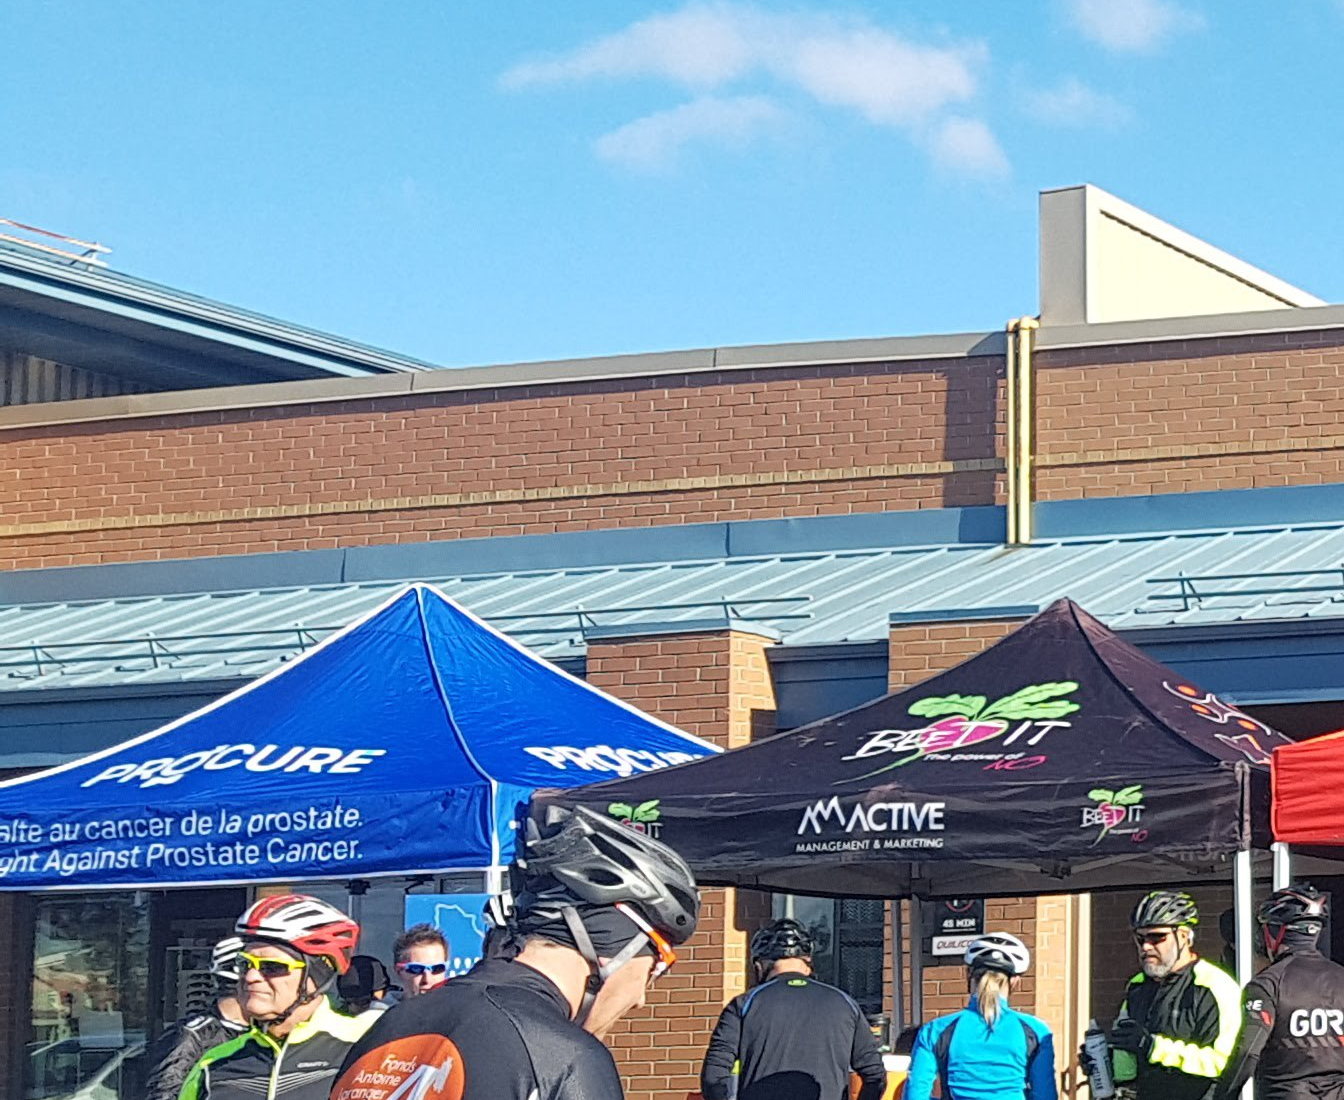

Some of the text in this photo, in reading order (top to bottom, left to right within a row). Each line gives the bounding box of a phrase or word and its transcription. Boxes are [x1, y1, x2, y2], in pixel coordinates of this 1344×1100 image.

[840, 720, 1072, 762] BEET IT
[79, 742, 388, 789] PROCURE
[49, 822, 80, 843] au
[84, 815, 174, 841] cancer
[180, 809, 213, 836] de
[218, 808, 244, 834] la
[246, 803, 364, 838] prostate.
[846, 801, 946, 833] ACTIVE
[42, 844, 141, 878] Against
[146, 840, 261, 869] Prostate
[265, 837, 364, 864] Cancer.
[795, 836, 944, 853] MANAGEMENT & MARKETING
[956, 918, 976, 928] MIN
[352, 1069, 402, 1087] Antoine
[380, 1053, 418, 1073] Fonds
